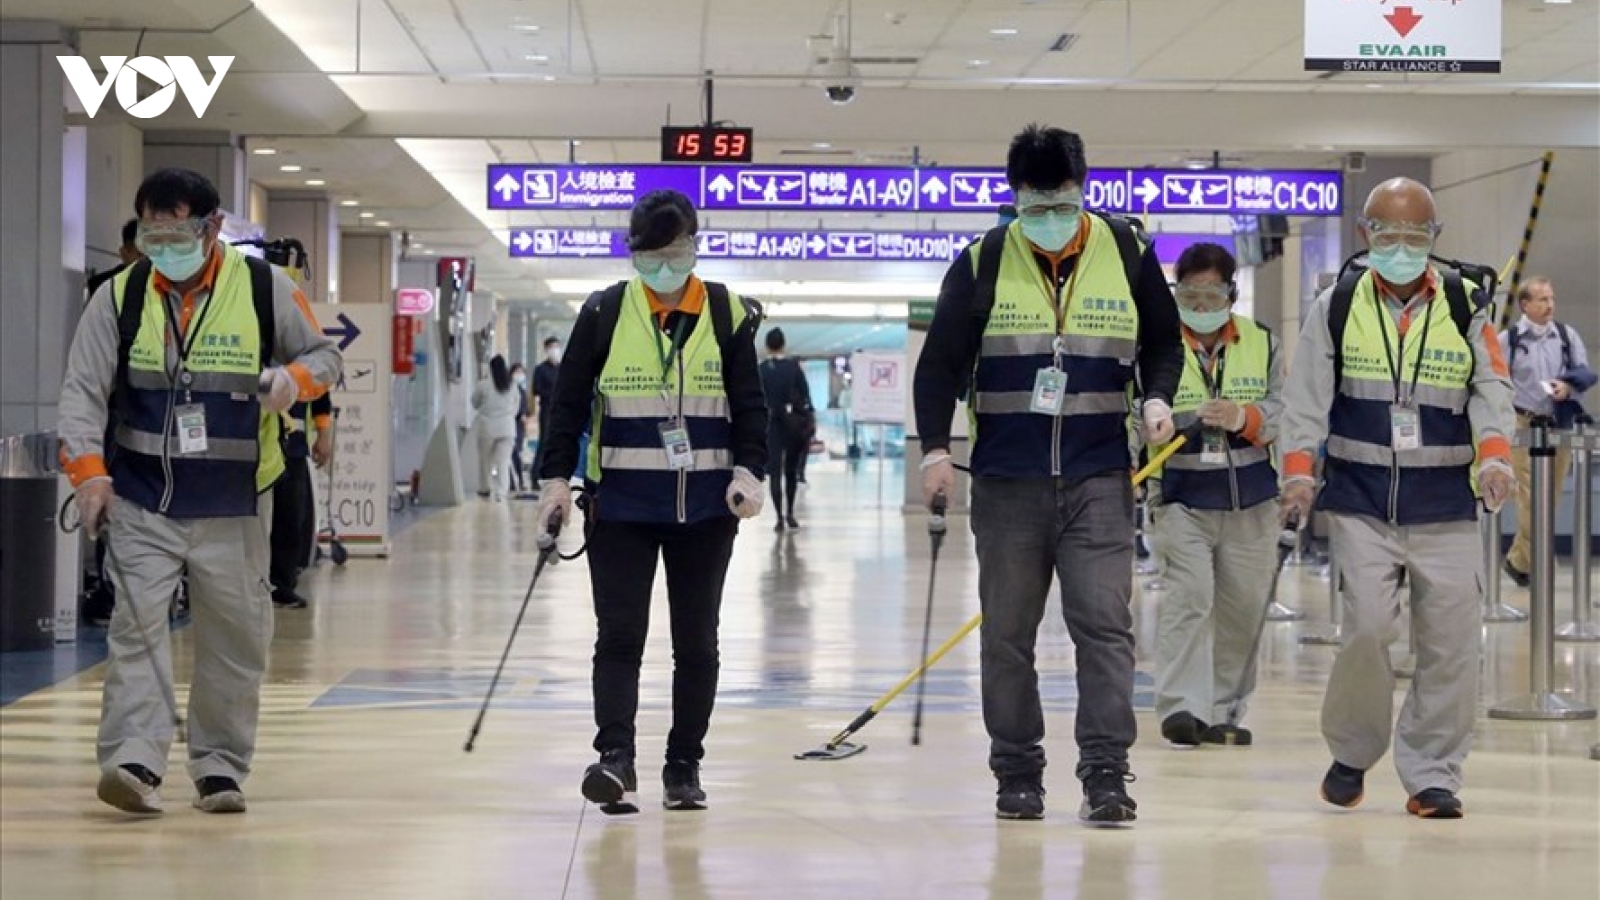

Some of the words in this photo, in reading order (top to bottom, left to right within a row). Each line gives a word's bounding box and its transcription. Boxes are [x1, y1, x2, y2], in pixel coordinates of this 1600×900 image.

[1359, 43, 1403, 56] EVA
[1407, 44, 1446, 57] AIR
[1343, 61, 1377, 71] STAR
[1381, 61, 1446, 72] ALLIANCE
[677, 133, 700, 156] 15
[714, 133, 746, 156] 53
[560, 192, 635, 207] Immigration
[849, 178, 912, 206] A1-A9
[1084, 180, 1125, 208] -D10
[1274, 181, 1338, 211] C1-C10
[758, 236, 801, 256] A1-A9
[904, 238, 948, 258] D1-D10
